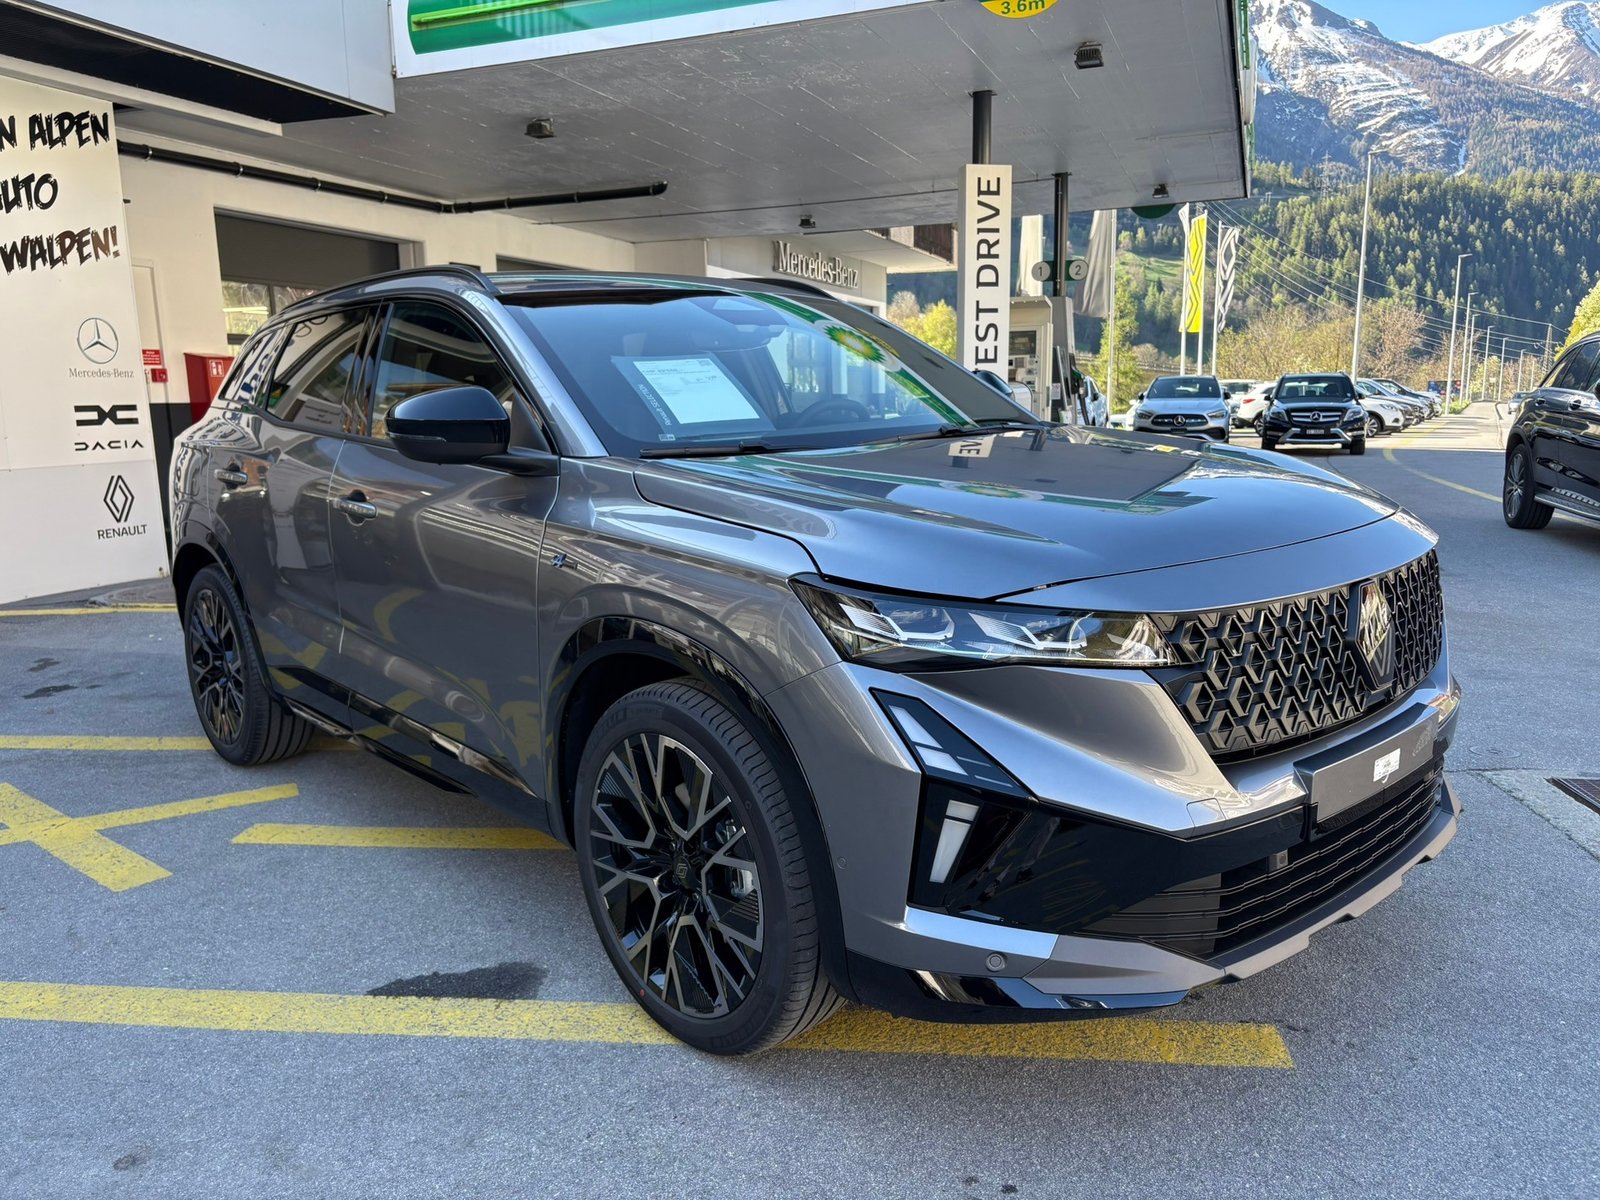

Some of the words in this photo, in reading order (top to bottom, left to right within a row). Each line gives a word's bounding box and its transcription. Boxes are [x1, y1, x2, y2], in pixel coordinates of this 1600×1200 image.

[1001, 0, 1045, 14] 3.6m
[28, 110, 110, 151] ALPEN
[0, 172, 58, 214] UTO
[0, 225, 121, 276] WALPEN!
[976, 176, 1001, 289] DRIVE
[774, 240, 859, 289] Mercedes-Benz
[1074, 264, 1082, 276] 2
[974, 300, 999, 372] EST
[68, 367, 135, 378] Mercedes-Benz
[74, 439, 144, 452] DACIA
[97, 524, 148, 540] RENAULT
